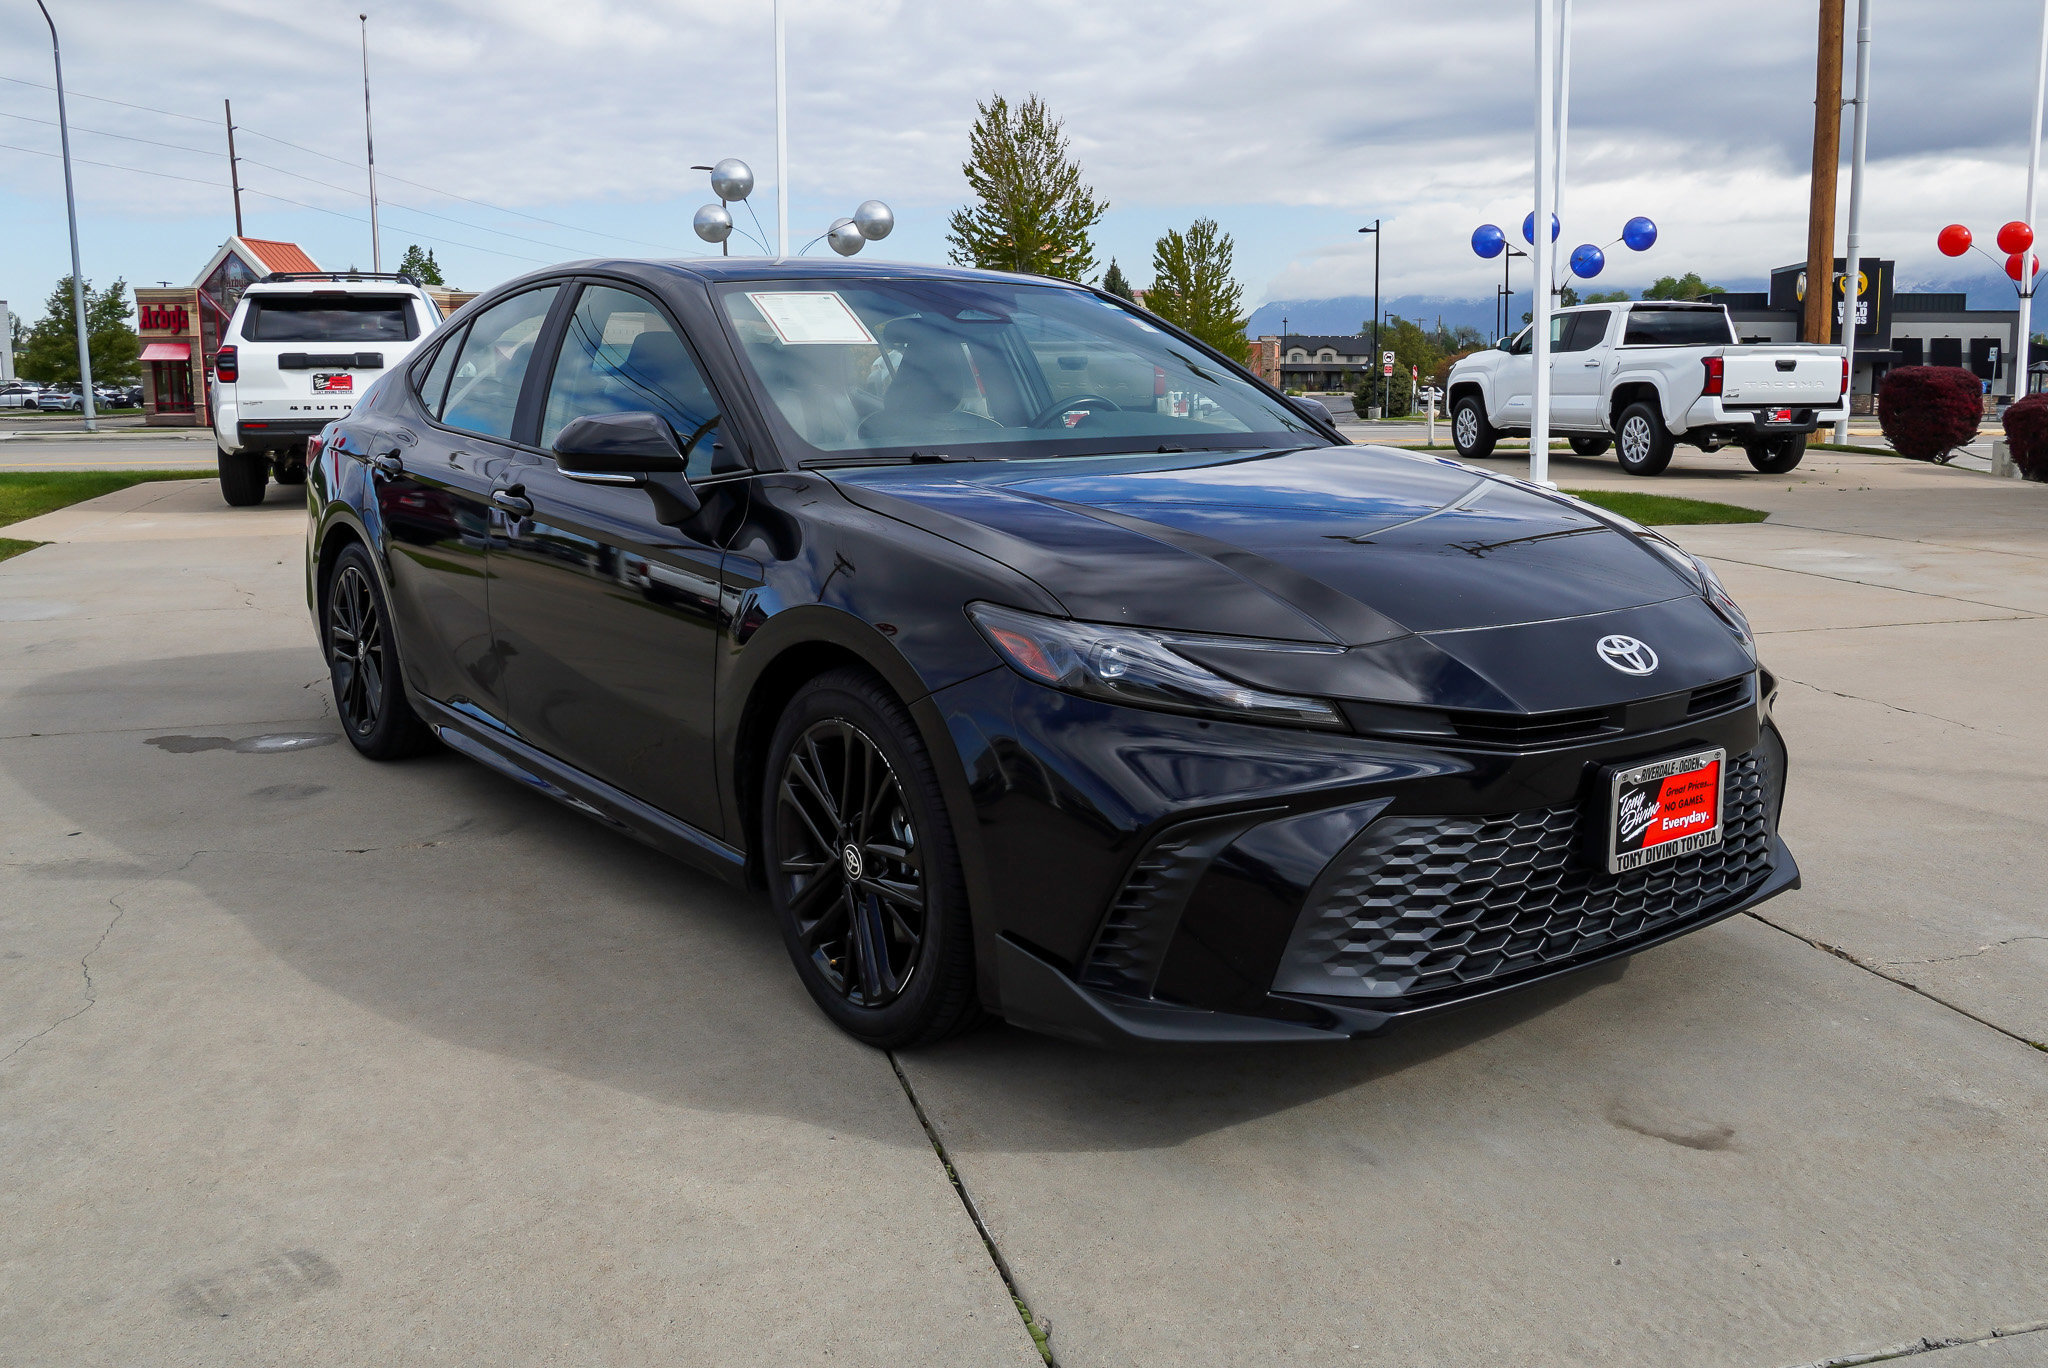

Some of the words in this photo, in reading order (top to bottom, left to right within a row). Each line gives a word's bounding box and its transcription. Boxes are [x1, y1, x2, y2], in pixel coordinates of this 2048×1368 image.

[140, 304, 189, 334] Arby's
[1837, 316, 1867, 324] WGS
[1744, 381, 1824, 390] TACOMA
[1641, 764, 1676, 782] RIVERDALE
[1679, 757, 1700, 772] OGDEN
[1666, 785, 1686, 796] Great
[1620, 788, 1646, 816] Tony
[1664, 802, 1676, 812] NO
[1678, 794, 1705, 809] GAMES.
[1618, 802, 1661, 834] Divino
[1662, 810, 1709, 830] Everyday.
[1617, 854, 1643, 871] TONY
[1646, 842, 1679, 863] DIVINO
[1681, 830, 1717, 851] TOYOTA
